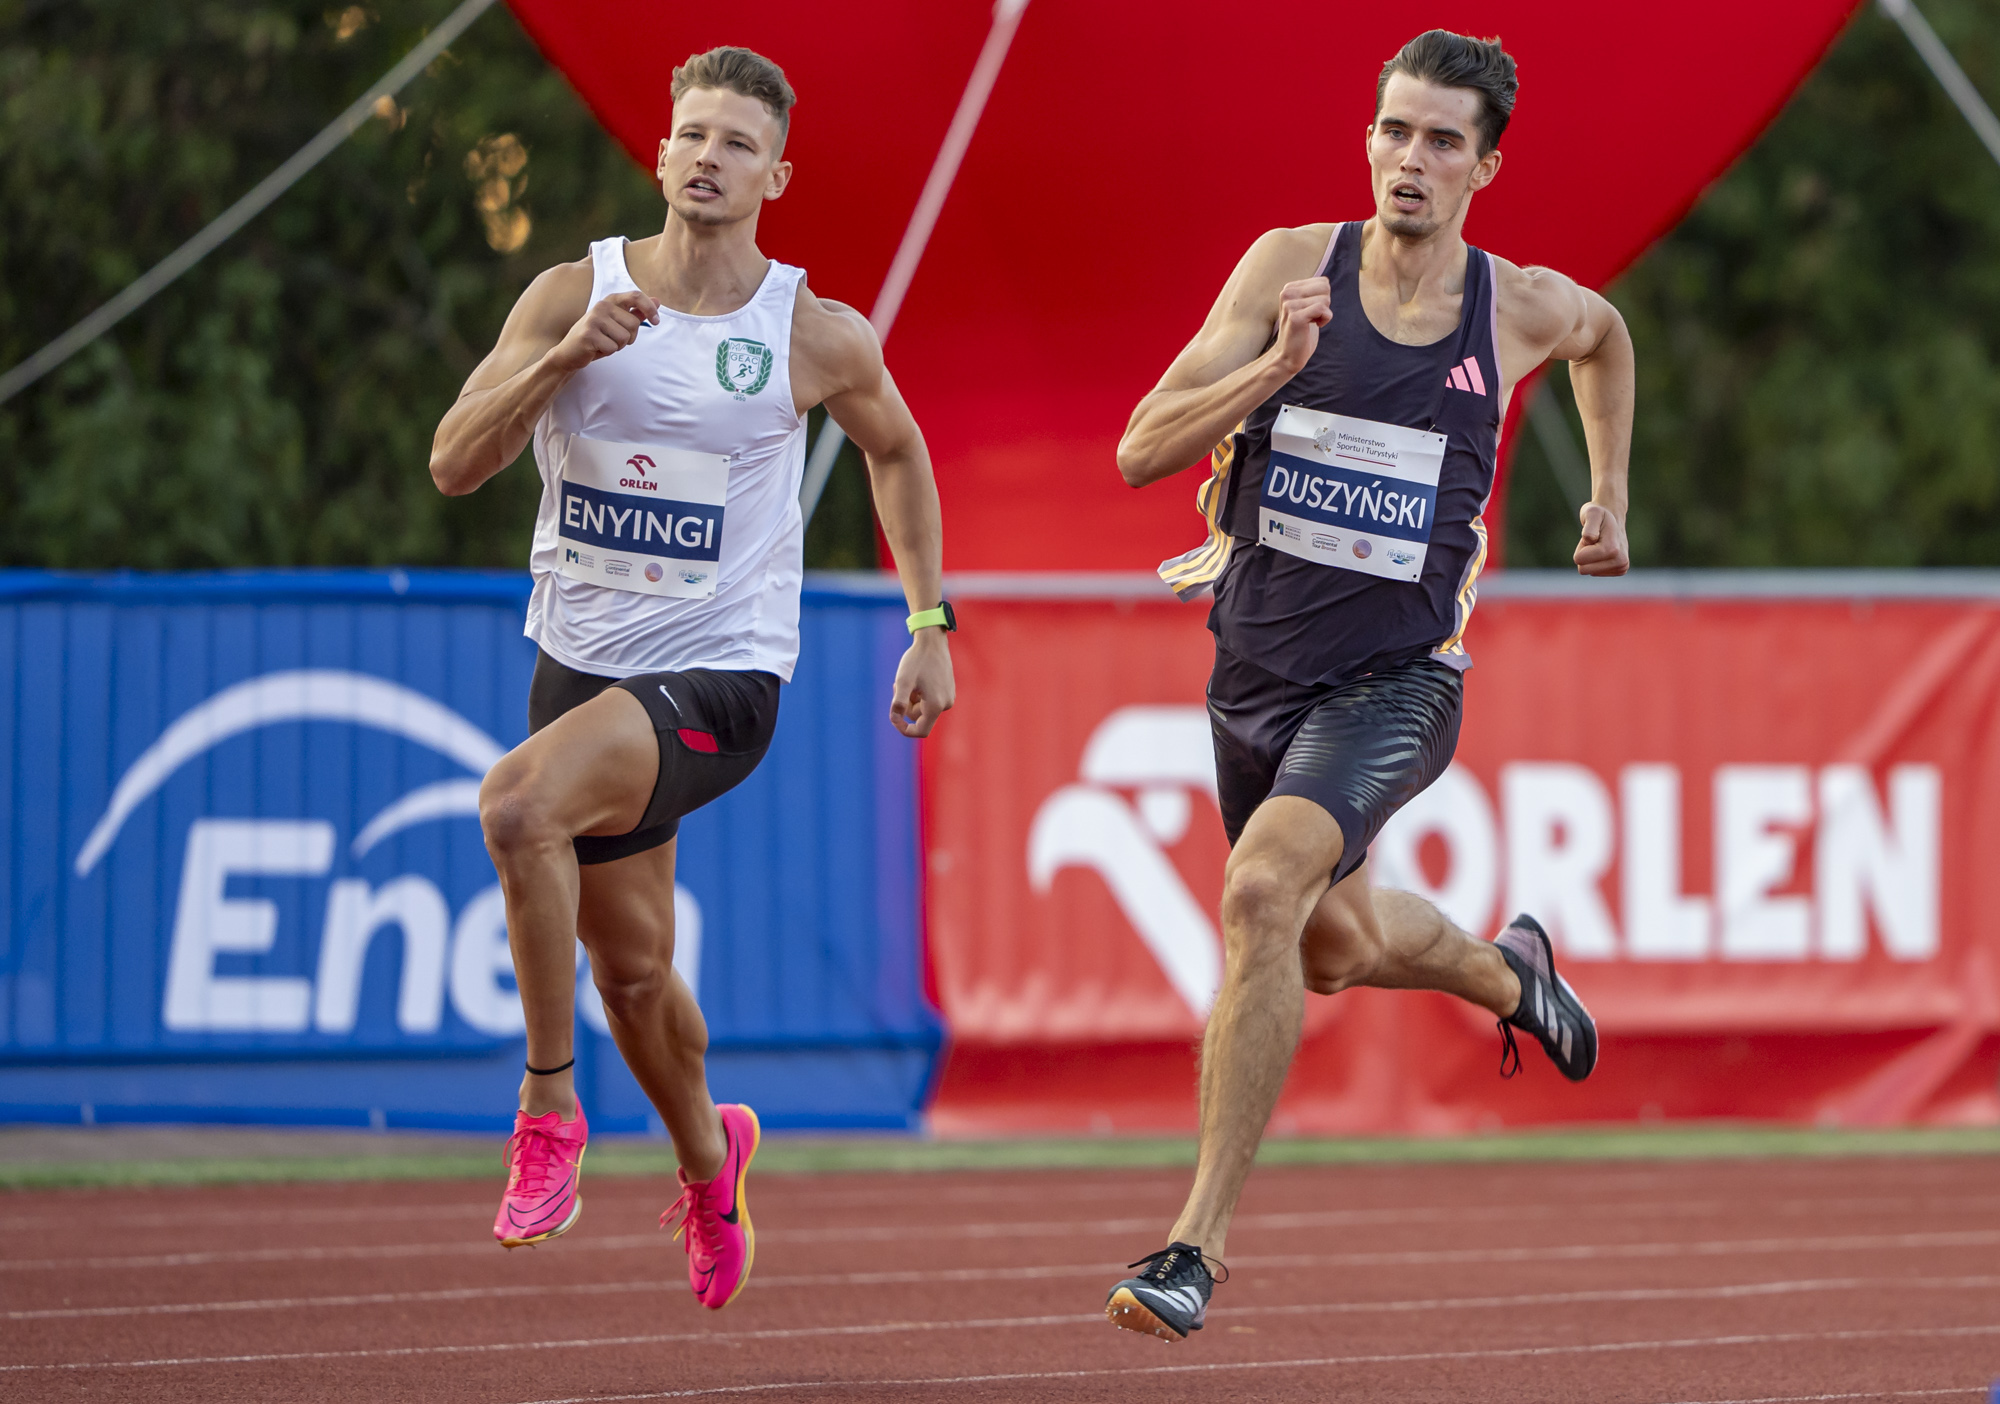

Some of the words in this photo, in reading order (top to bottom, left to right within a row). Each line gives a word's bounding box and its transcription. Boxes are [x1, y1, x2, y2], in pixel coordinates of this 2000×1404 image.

[730, 354, 759, 365] GEAC
[1338, 433, 1386, 448] Ministerstwo
[1336, 441, 1361, 453] Sportu
[1366, 446, 1399, 460] Turystyki
[619, 478, 658, 491] ORLEN
[1267, 465, 1427, 530] DUSZYŃSKI
[565, 494, 715, 549] ENYINGI
[1367, 761, 1942, 963] ORLEN
